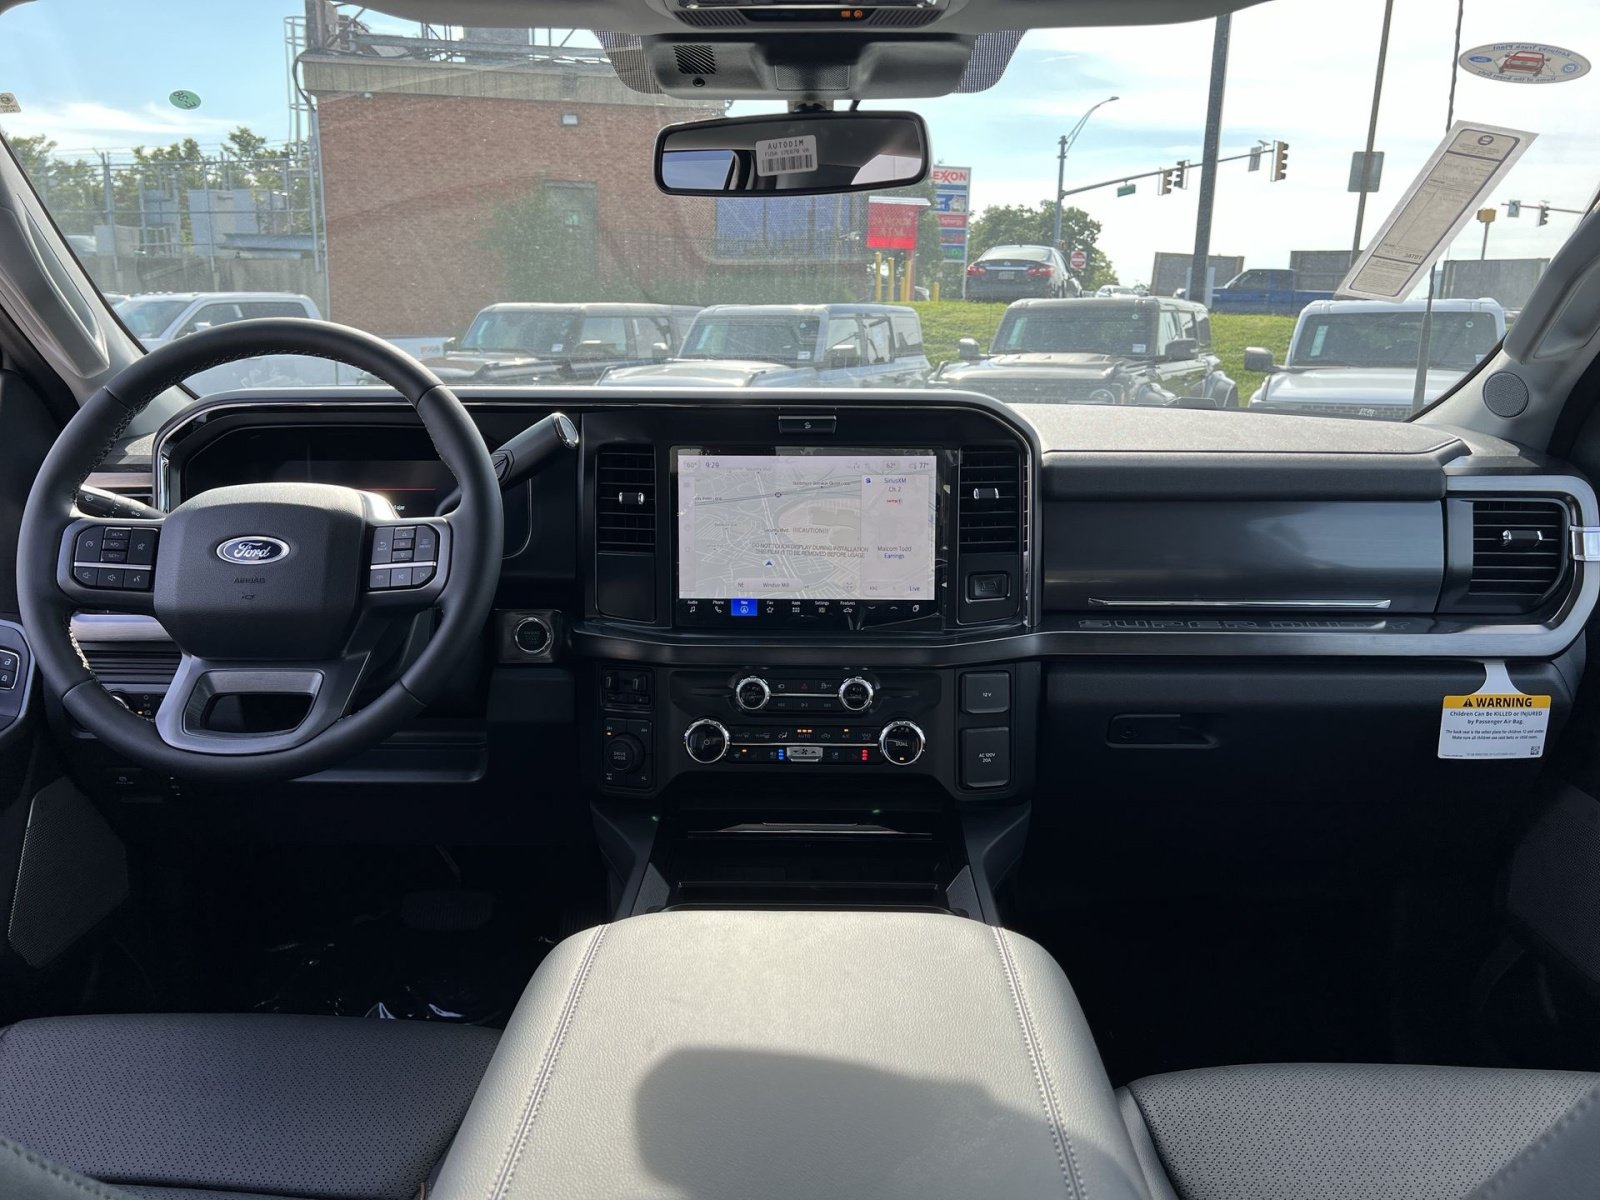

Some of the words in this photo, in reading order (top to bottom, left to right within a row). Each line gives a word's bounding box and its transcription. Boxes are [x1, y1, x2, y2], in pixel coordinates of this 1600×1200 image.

[767, 139, 804, 150] AUTODIM
[933, 170, 967, 183] EXXON
[234, 541, 272, 558] Ford
[1476, 697, 1532, 708] WARNING
